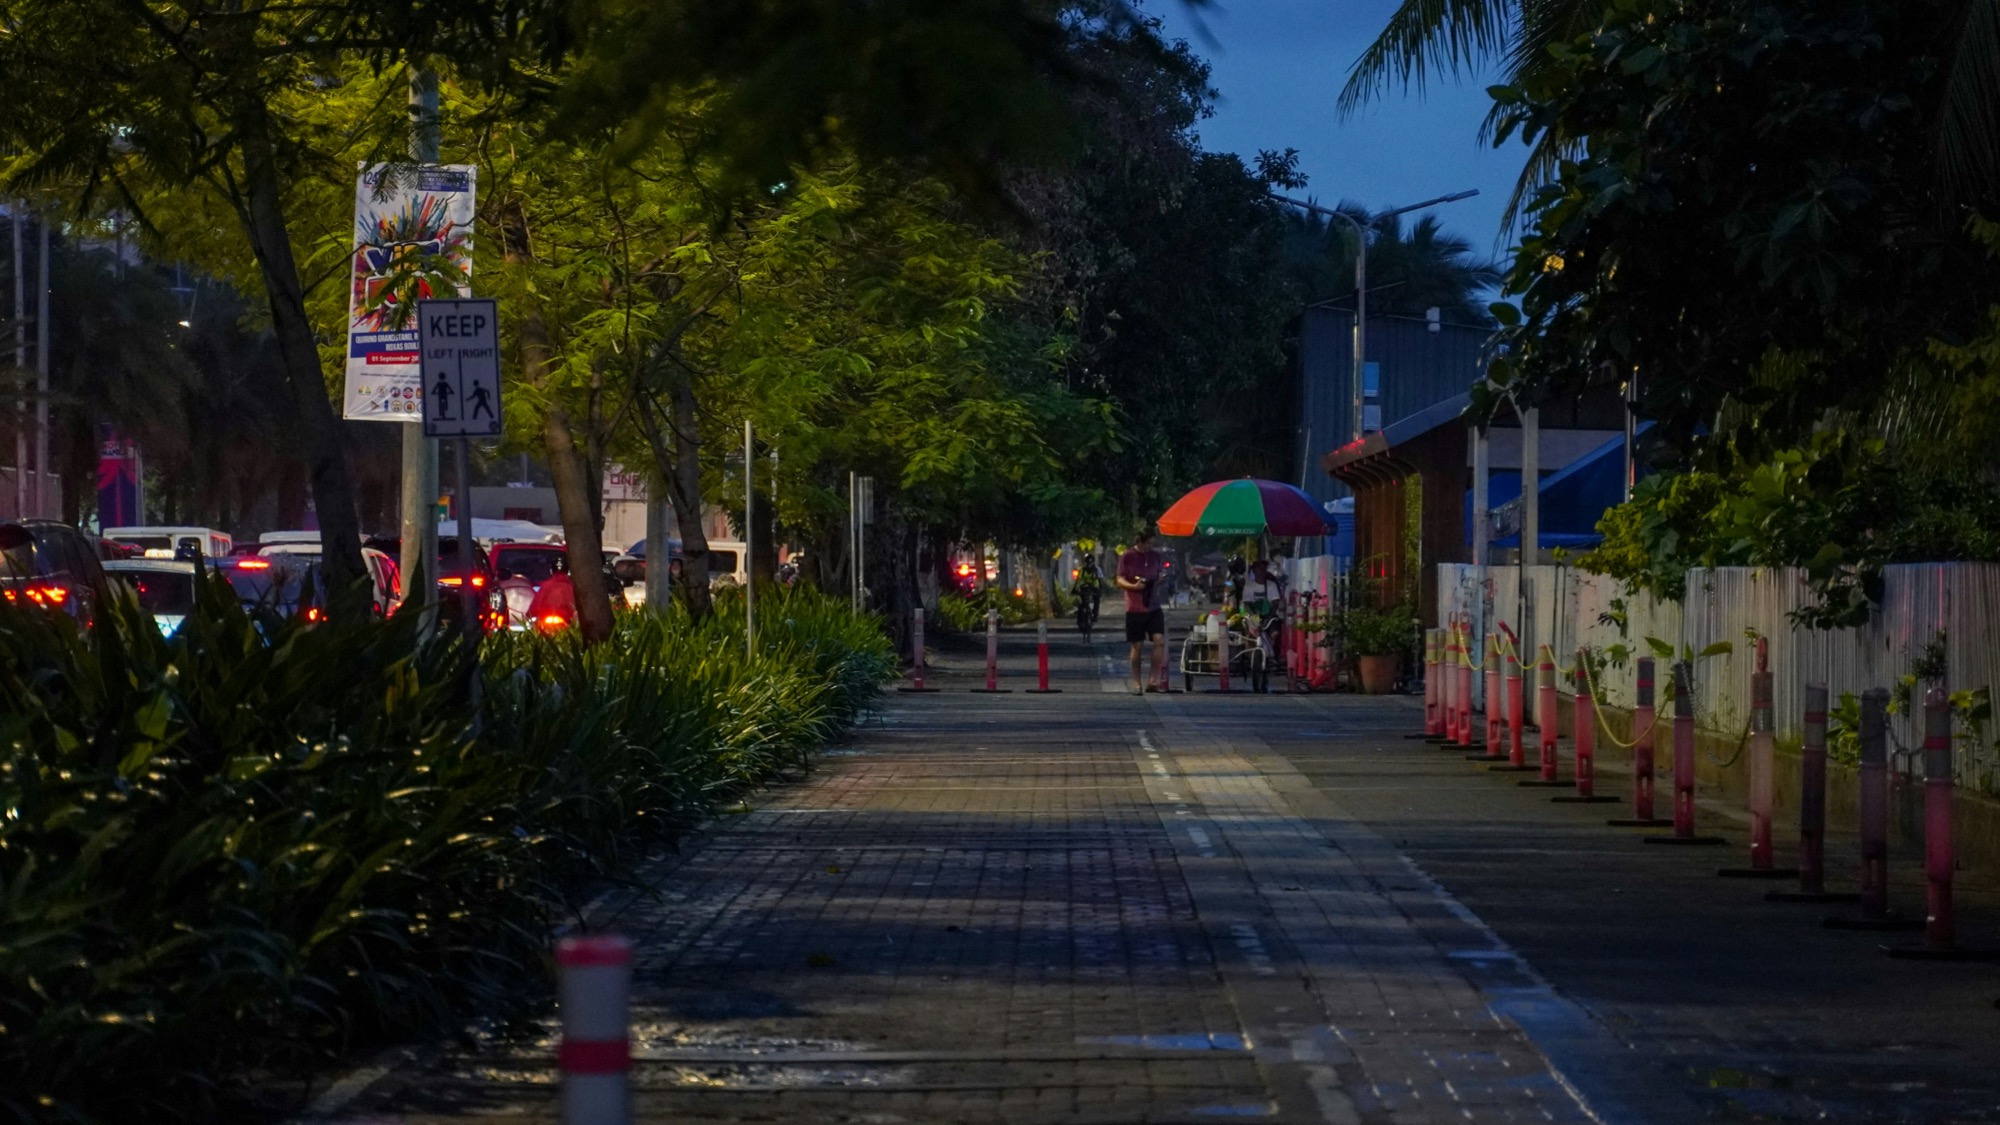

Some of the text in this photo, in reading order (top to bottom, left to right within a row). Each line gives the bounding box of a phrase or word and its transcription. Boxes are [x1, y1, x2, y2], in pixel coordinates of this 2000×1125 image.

[430, 314, 486, 338] KEEP
[355, 335, 378, 344] QUIRINO
[386, 343, 404, 352] ROXAS
[428, 347, 494, 359] LEFT RIGHT
[380, 355, 411, 363] September
